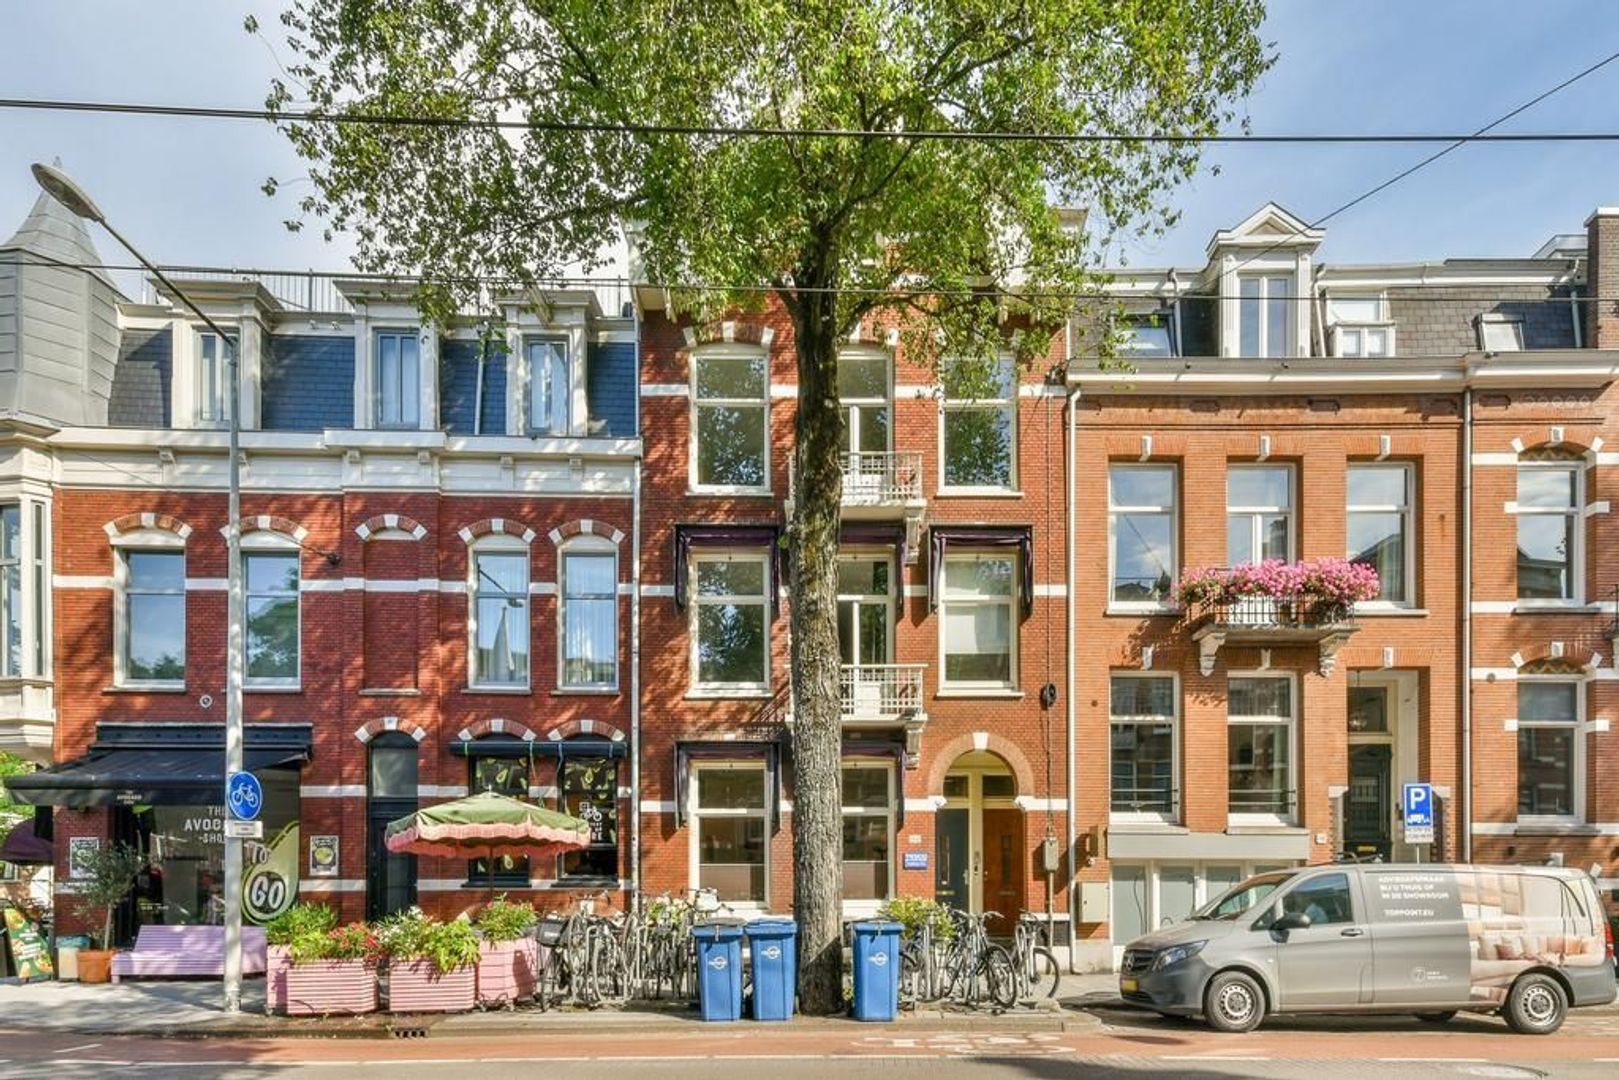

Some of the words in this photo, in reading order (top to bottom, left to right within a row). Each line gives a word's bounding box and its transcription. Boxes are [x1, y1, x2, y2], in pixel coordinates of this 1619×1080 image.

[1410, 788, 1426, 810] P
[184, 819, 226, 832] AVOC
[251, 875, 284, 909] GO
